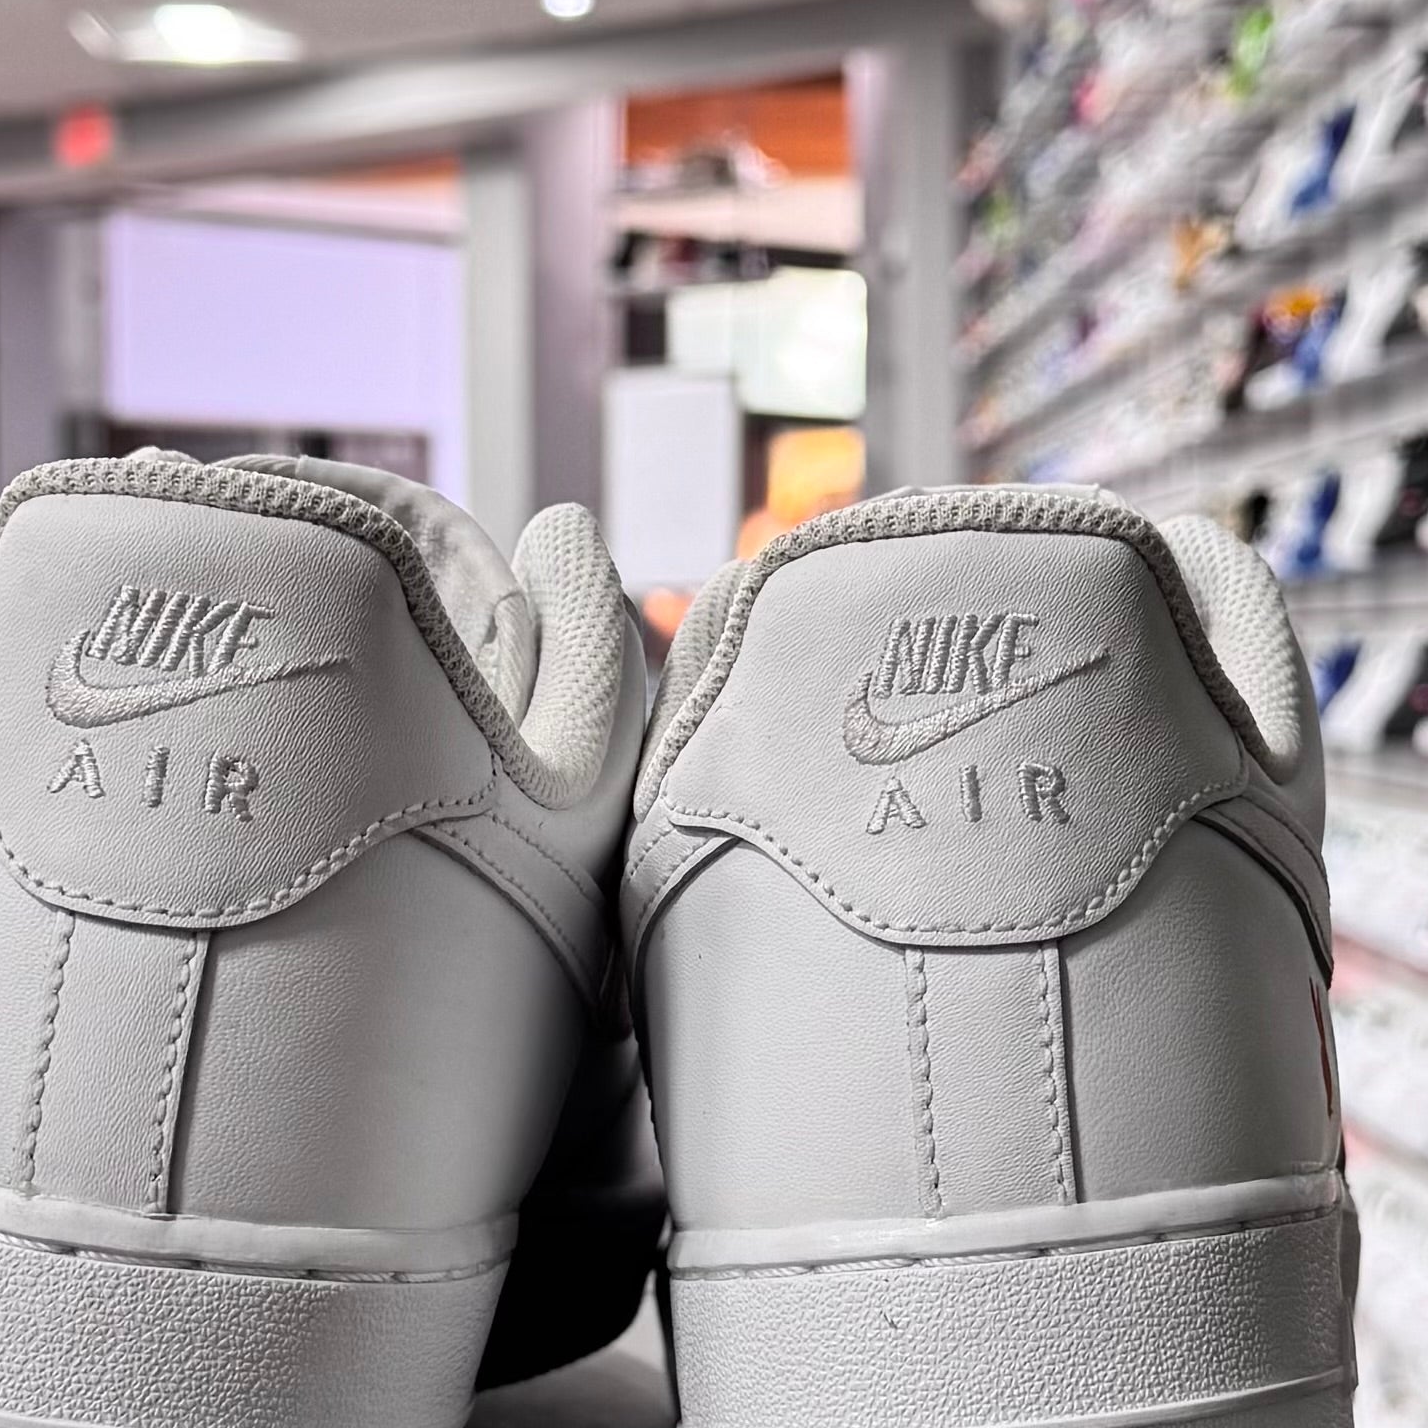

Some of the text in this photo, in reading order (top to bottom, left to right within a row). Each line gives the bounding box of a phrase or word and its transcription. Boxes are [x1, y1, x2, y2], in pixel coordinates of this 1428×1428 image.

[85, 584, 275, 677] NIKE
[872, 612, 1040, 698] NIKE
[46, 738, 260, 823] AIR
[865, 762, 1072, 835] AIR
